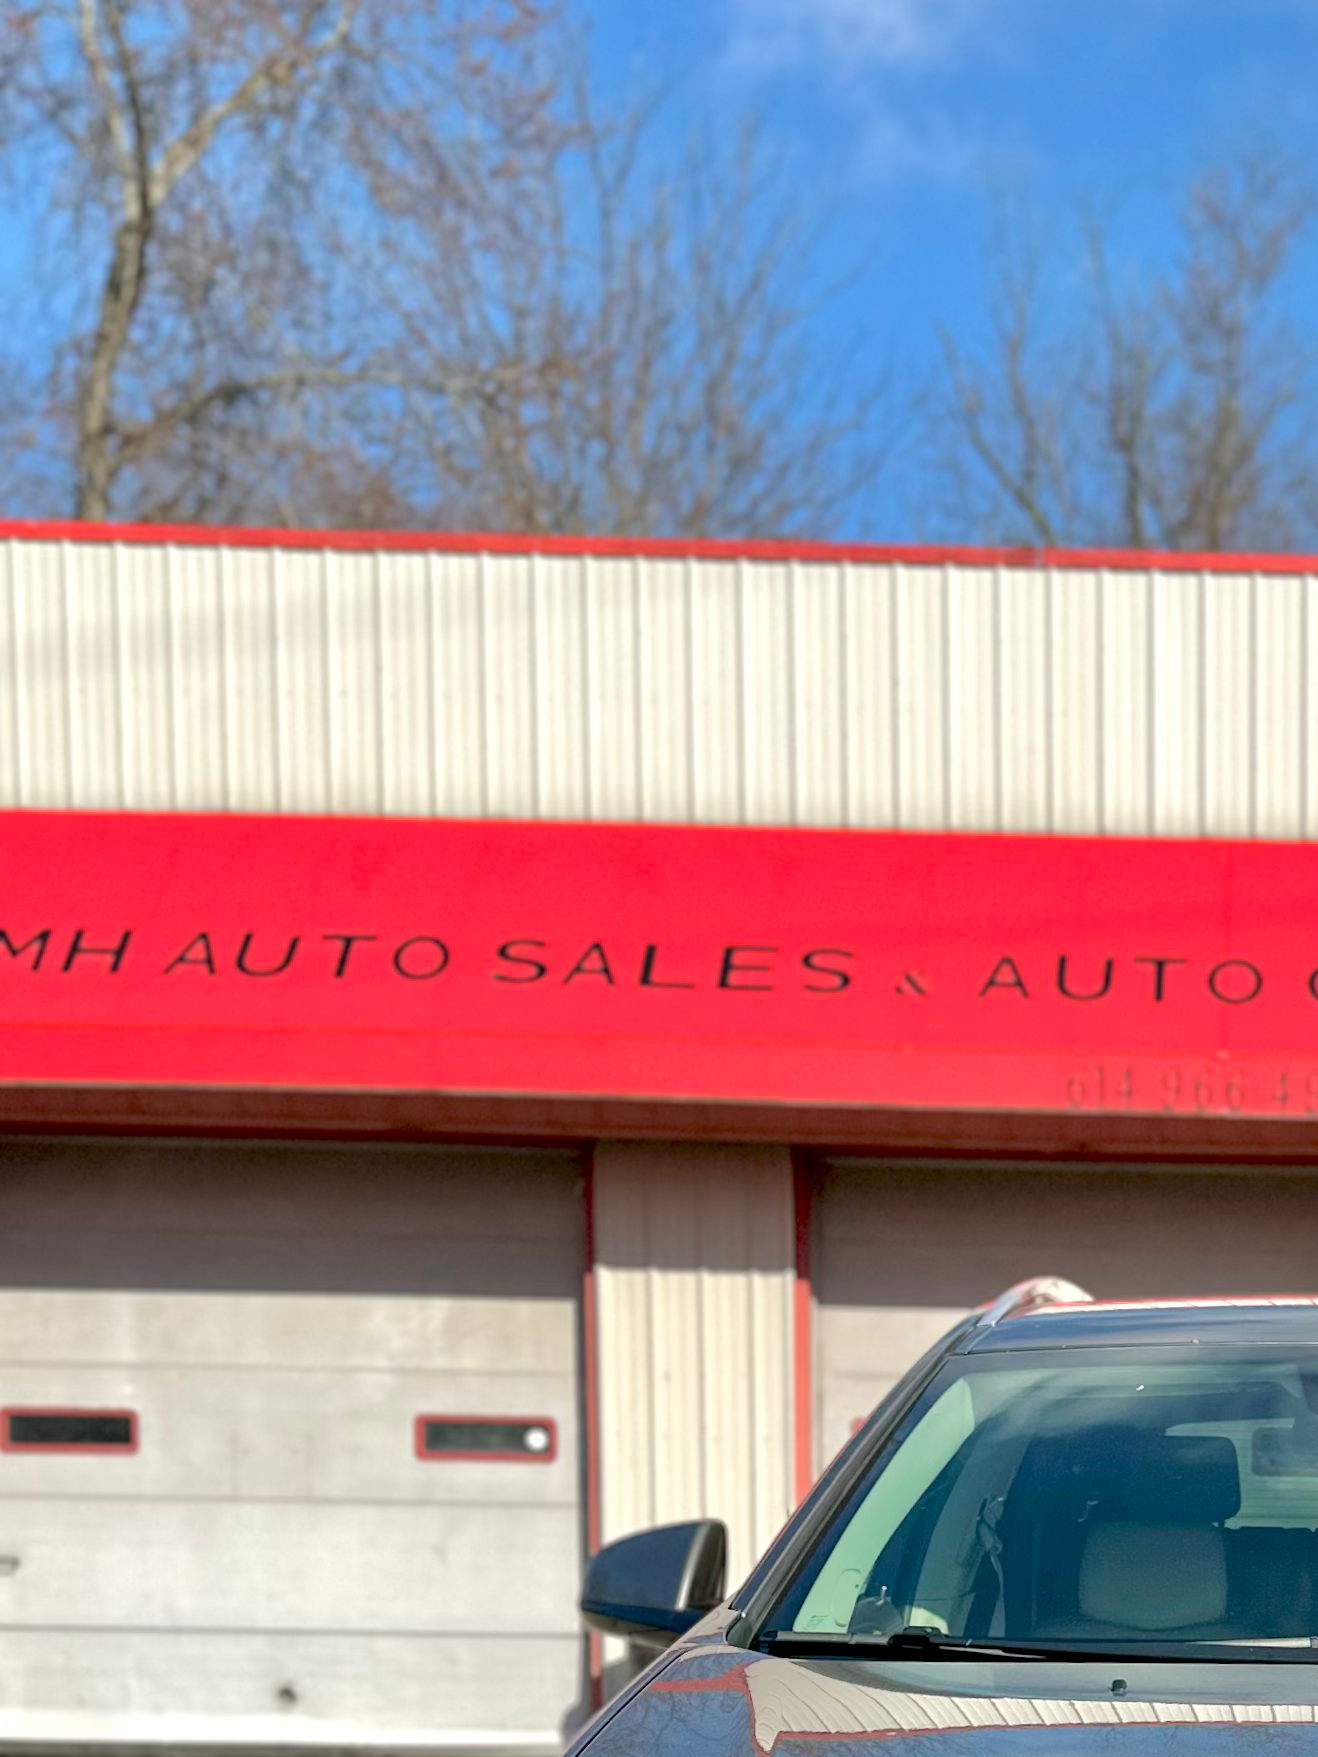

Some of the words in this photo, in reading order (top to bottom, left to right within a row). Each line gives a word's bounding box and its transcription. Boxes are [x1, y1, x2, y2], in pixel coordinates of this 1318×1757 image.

[164, 931, 451, 981] AUTO
[492, 940, 854, 994] SALES
[979, 955, 1264, 1004] AUTO
[1066, 1065, 1134, 1110] 614
[1161, 1068, 1246, 1114] 966
